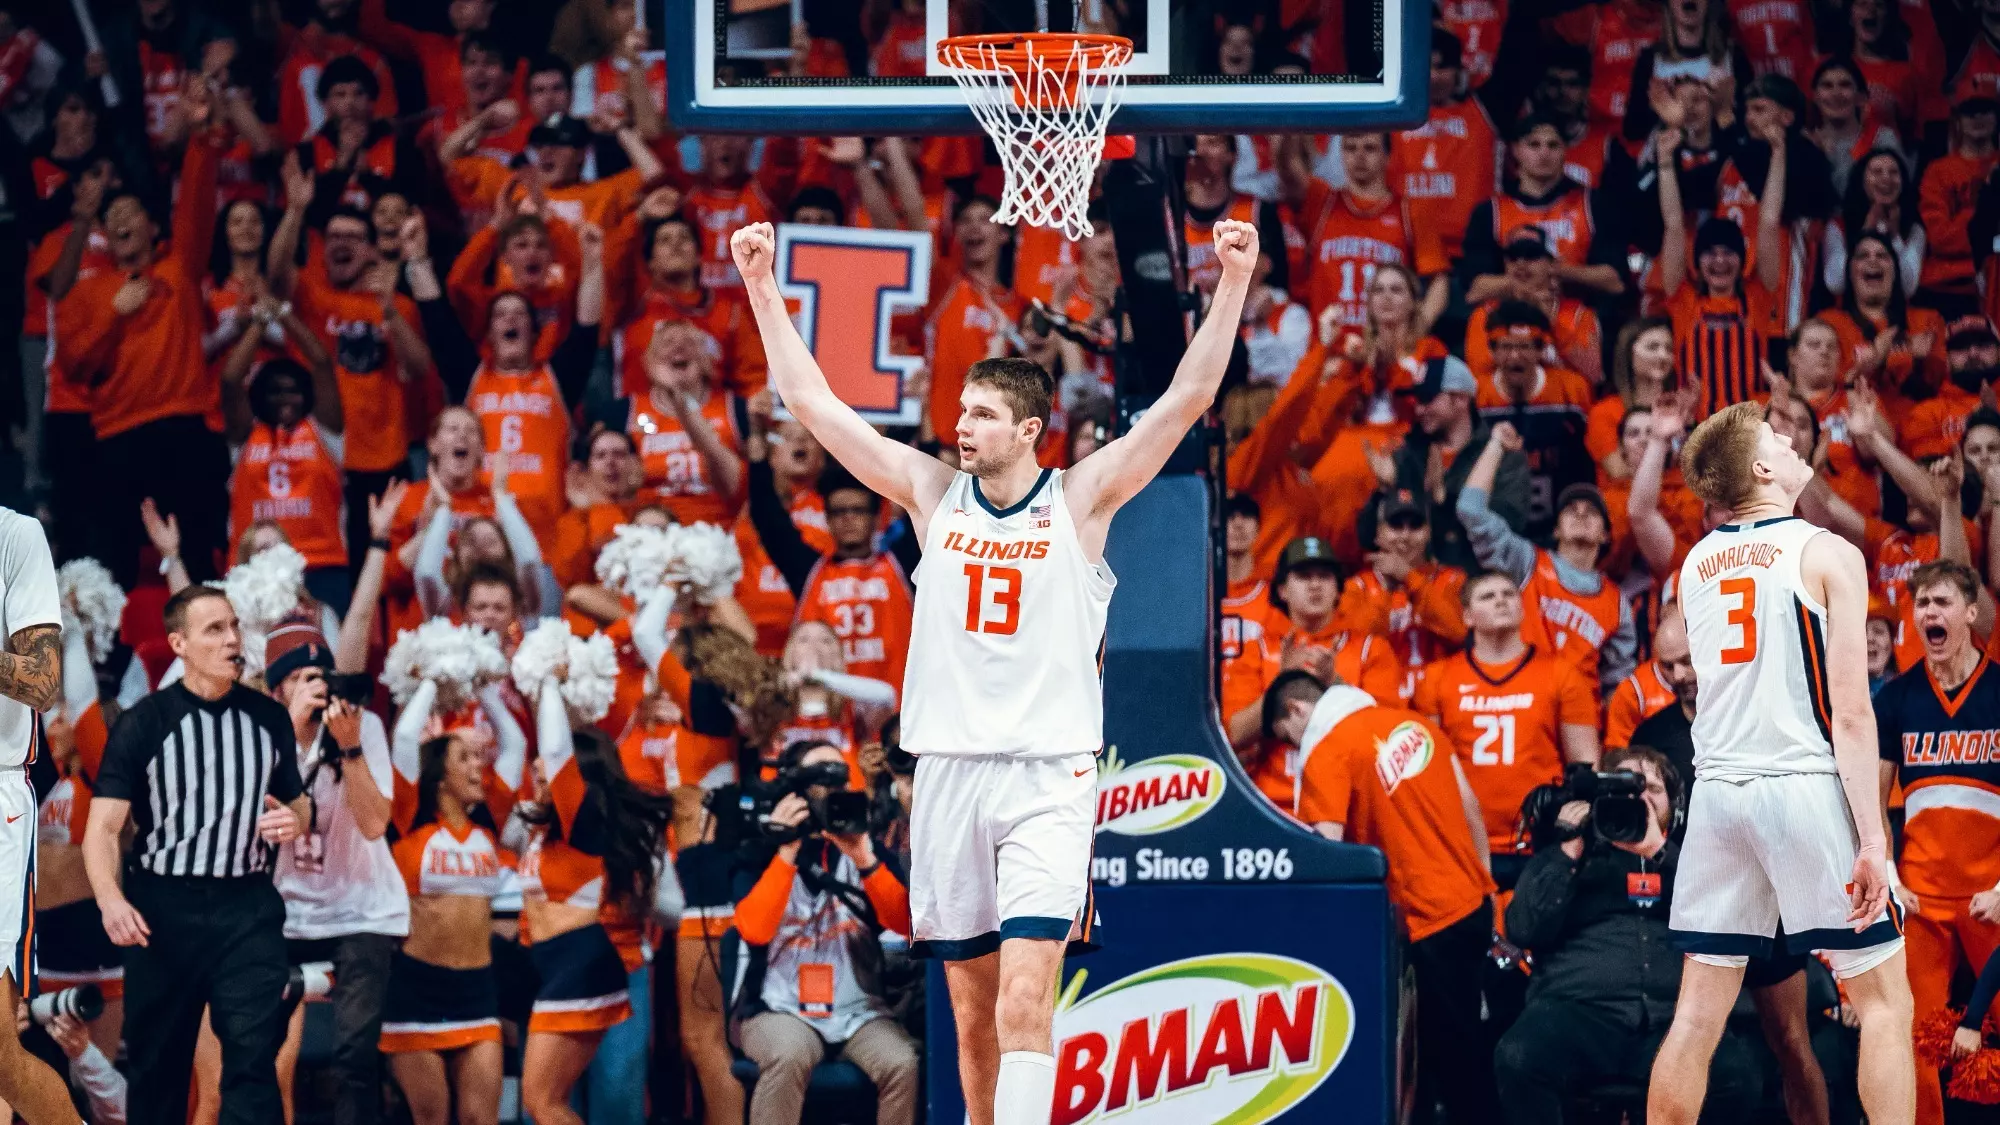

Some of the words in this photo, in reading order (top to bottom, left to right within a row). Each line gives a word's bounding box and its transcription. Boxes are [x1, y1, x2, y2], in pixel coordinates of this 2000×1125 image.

[500, 415, 522, 453] 6
[268, 461, 291, 499] 6
[943, 531, 1050, 561] ILLINOIS
[1697, 542, 1783, 583] HUMRICHOUS
[834, 602, 875, 637] 33
[963, 563, 1023, 636] 13
[1719, 576, 1758, 665] 3
[1472, 714, 1516, 767] 21
[1095, 769, 1212, 826] IBMAN
[1135, 848, 1210, 881] Since
[1221, 847, 1294, 881] 1896
[1049, 983, 1319, 1125] BMAN
